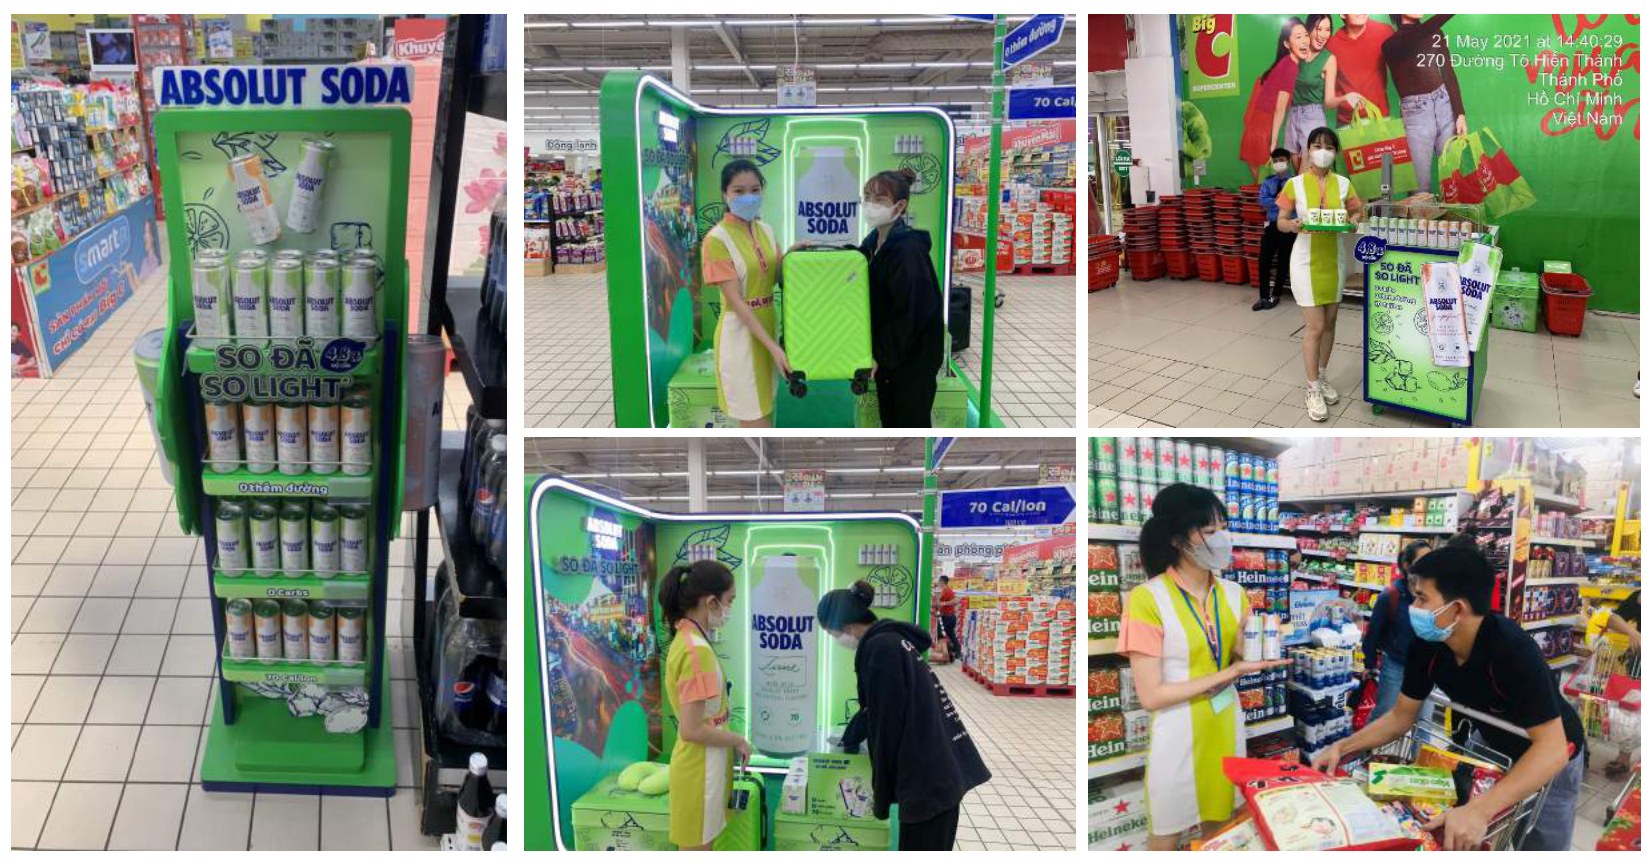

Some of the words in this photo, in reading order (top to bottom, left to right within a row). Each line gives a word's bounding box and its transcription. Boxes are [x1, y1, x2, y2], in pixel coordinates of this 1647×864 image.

[1192, 16, 1216, 34] Big
[160, 68, 307, 107] ABSOLUT
[321, 67, 411, 105] SODA
[1034, 98, 1050, 107] 70
[798, 201, 857, 218] ABSOLUT
[807, 218, 848, 234] SODA
[1380, 262, 1395, 271] SO
[1375, 271, 1389, 280] SO
[1390, 272, 1420, 285] LIGHT
[1461, 286, 1483, 300] SODA
[1430, 298, 1458, 306] ABSOLUT
[218, 346, 261, 371] SO
[270, 338, 317, 371] ĐÃ
[203, 376, 247, 398] SO
[253, 377, 341, 398] LIGHT
[250, 483, 283, 493] thêm
[285, 483, 329, 495] đường
[969, 501, 988, 513] 70
[992, 499, 1047, 514] Cal/lon
[561, 556, 579, 573] SO
[601, 560, 613, 574] SO
[615, 560, 639, 575] LIGHT
[752, 614, 815, 633] ABSOLUT
[759, 632, 804, 650] SODA
